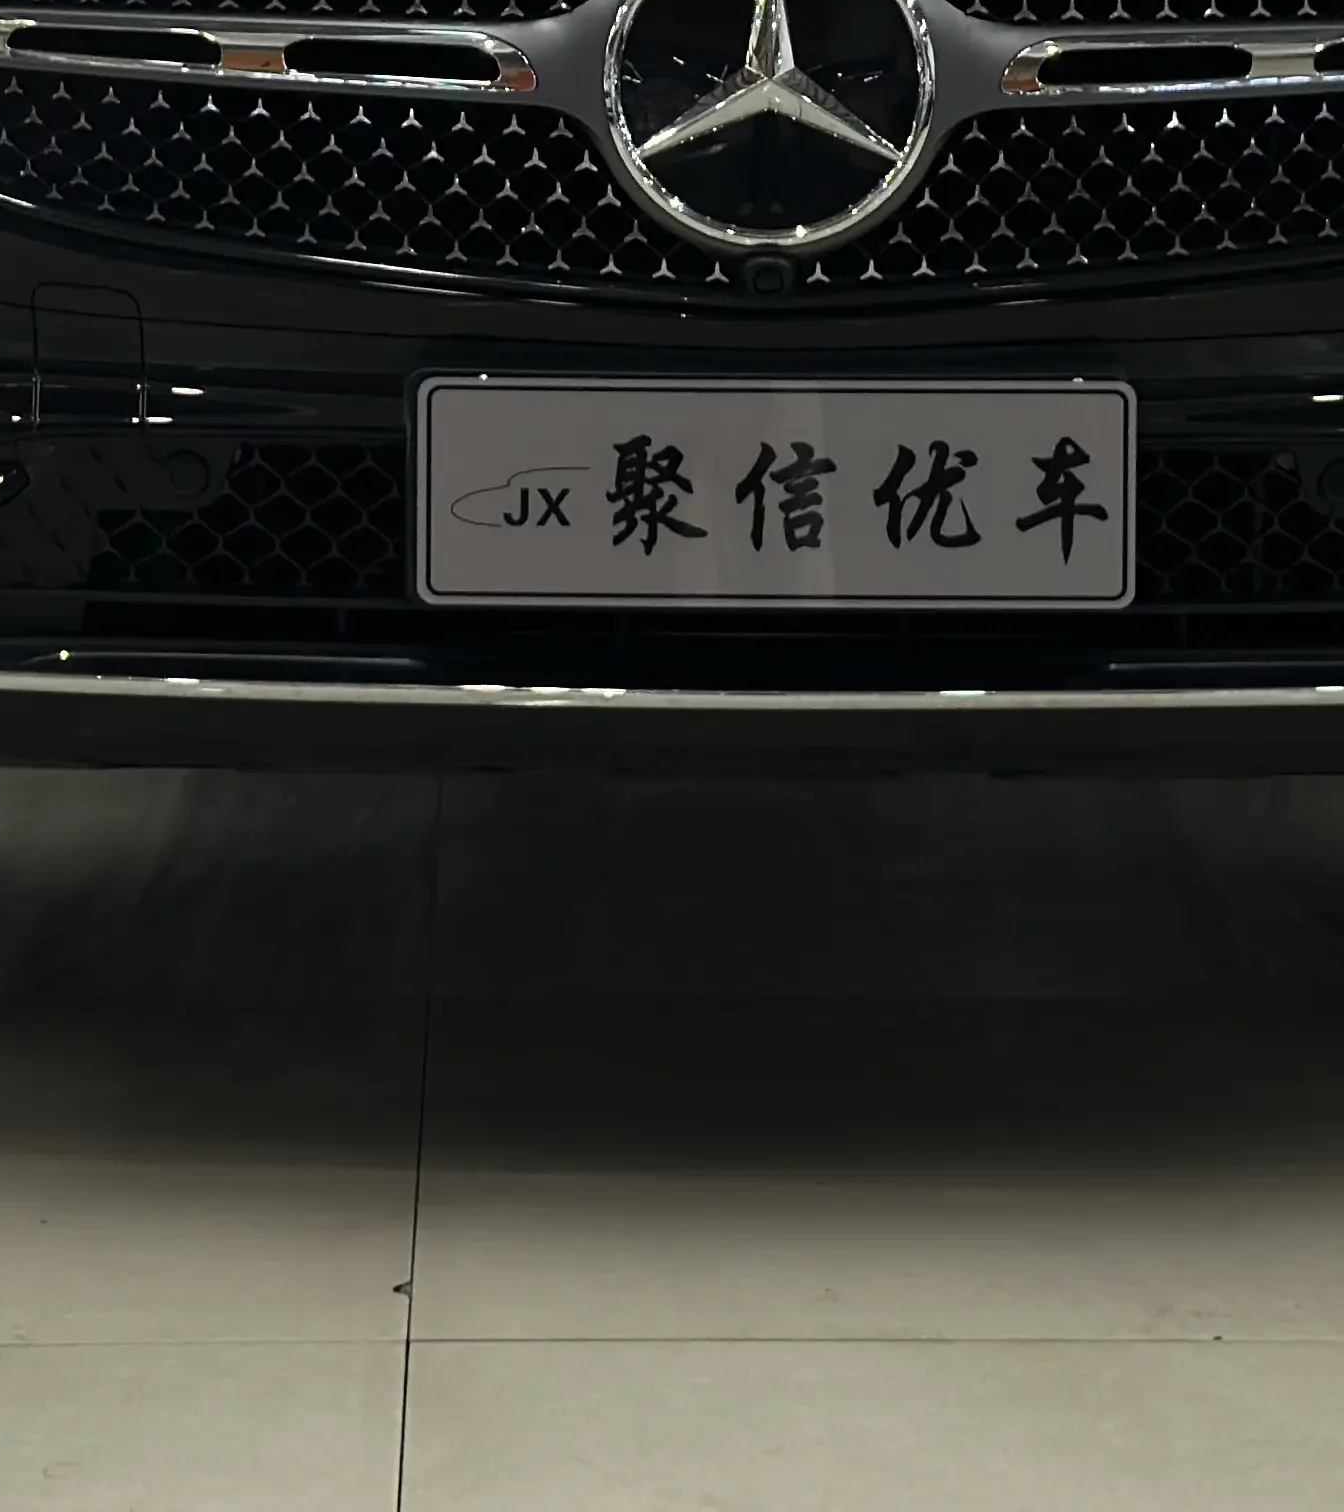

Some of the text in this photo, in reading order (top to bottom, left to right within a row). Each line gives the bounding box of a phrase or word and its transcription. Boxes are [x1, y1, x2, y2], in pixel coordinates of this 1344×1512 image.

[502, 434, 1109, 566] JX 聚信优车
